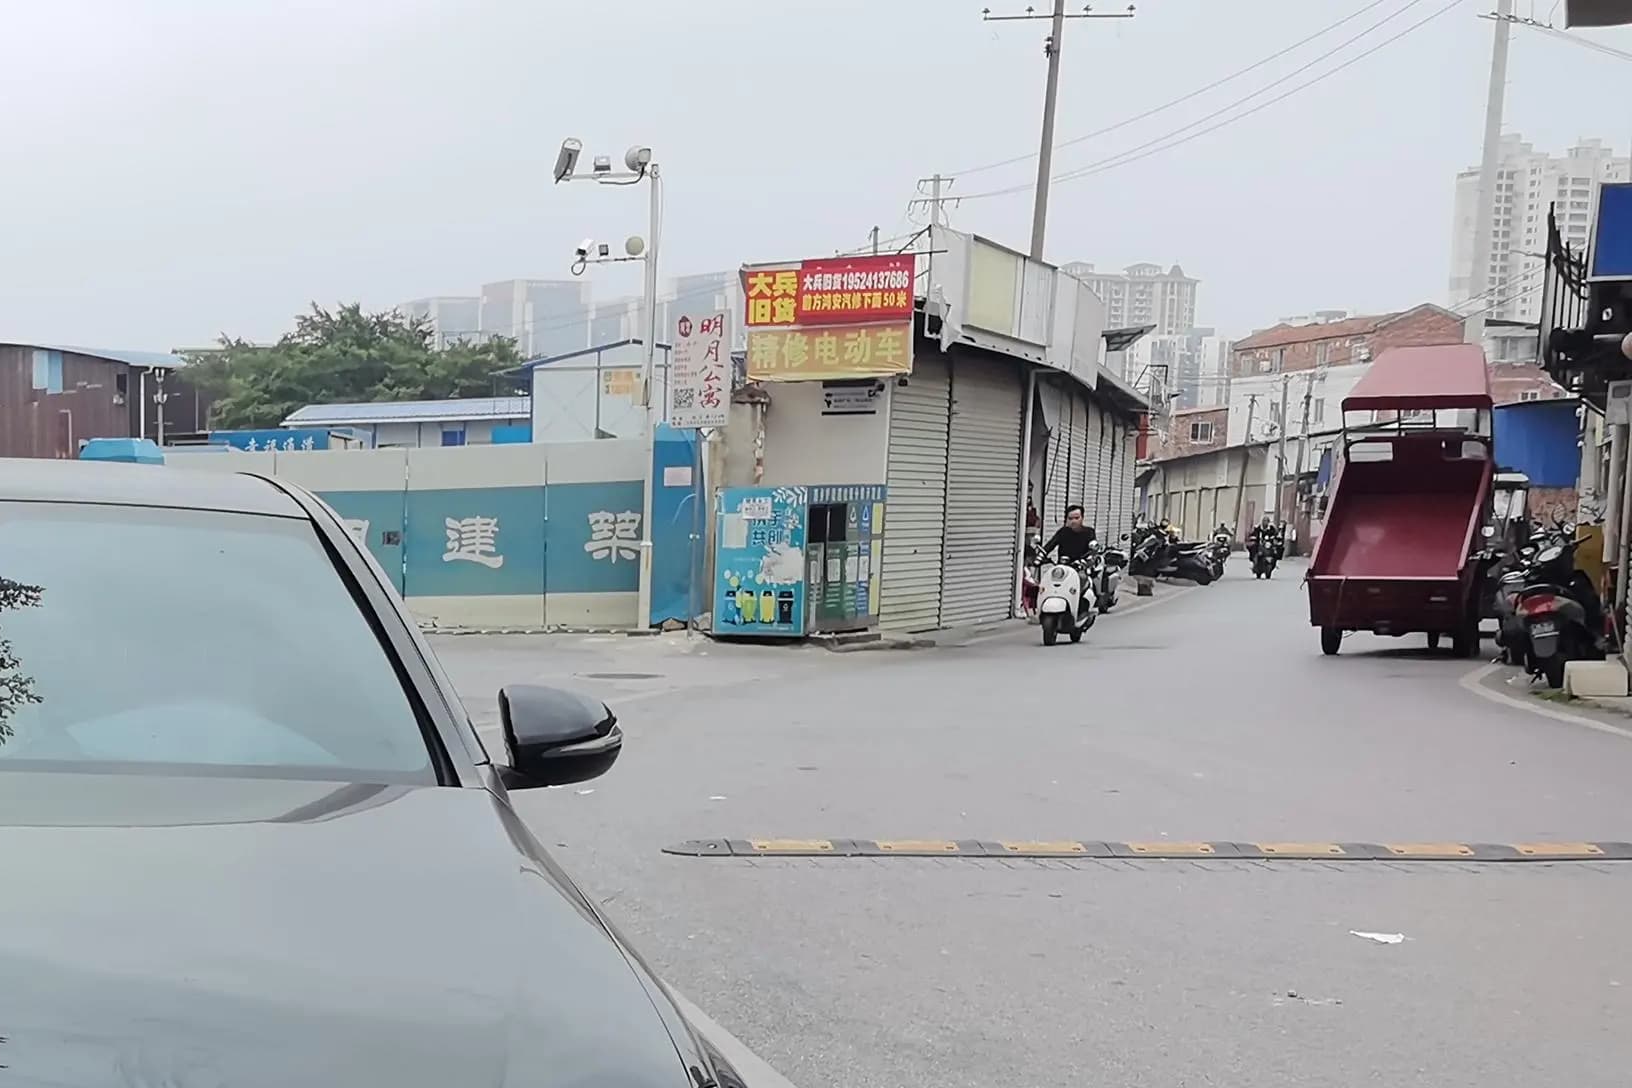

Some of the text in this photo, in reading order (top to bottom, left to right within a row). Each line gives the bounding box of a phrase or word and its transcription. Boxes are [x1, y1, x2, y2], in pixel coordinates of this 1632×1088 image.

[748, 271, 798, 297] 大兵
[748, 298, 797, 324] 旧货
[699, 313, 724, 408] 明月公寓
[750, 328, 904, 369] 精修电动车
